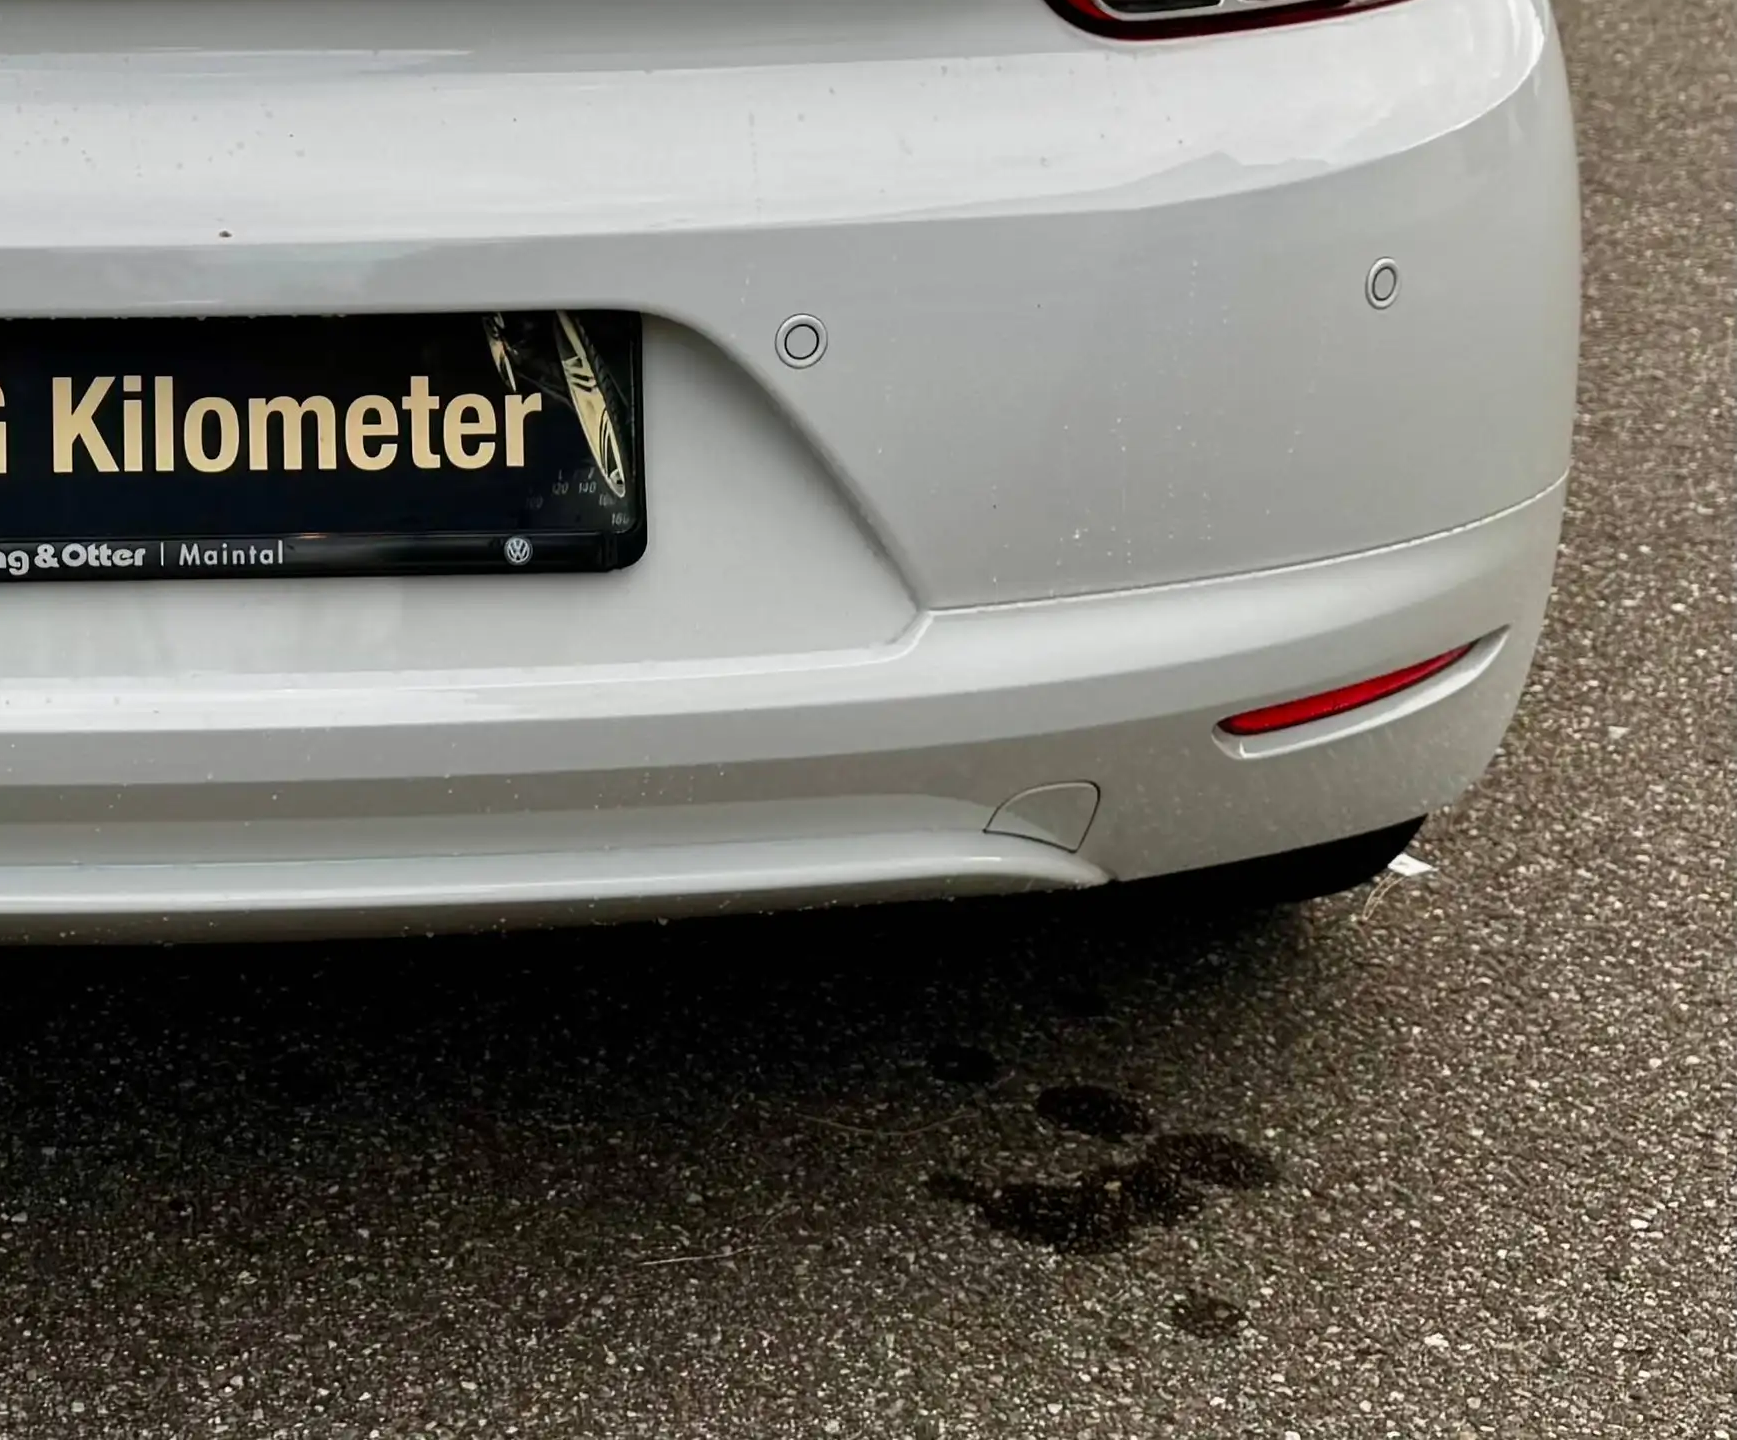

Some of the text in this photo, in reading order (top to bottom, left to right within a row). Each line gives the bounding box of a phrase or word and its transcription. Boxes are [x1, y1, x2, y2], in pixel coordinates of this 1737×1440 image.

[52, 375, 542, 472] Kilometer
[61, 543, 146, 567] Otter
[179, 540, 283, 566] Maintal
